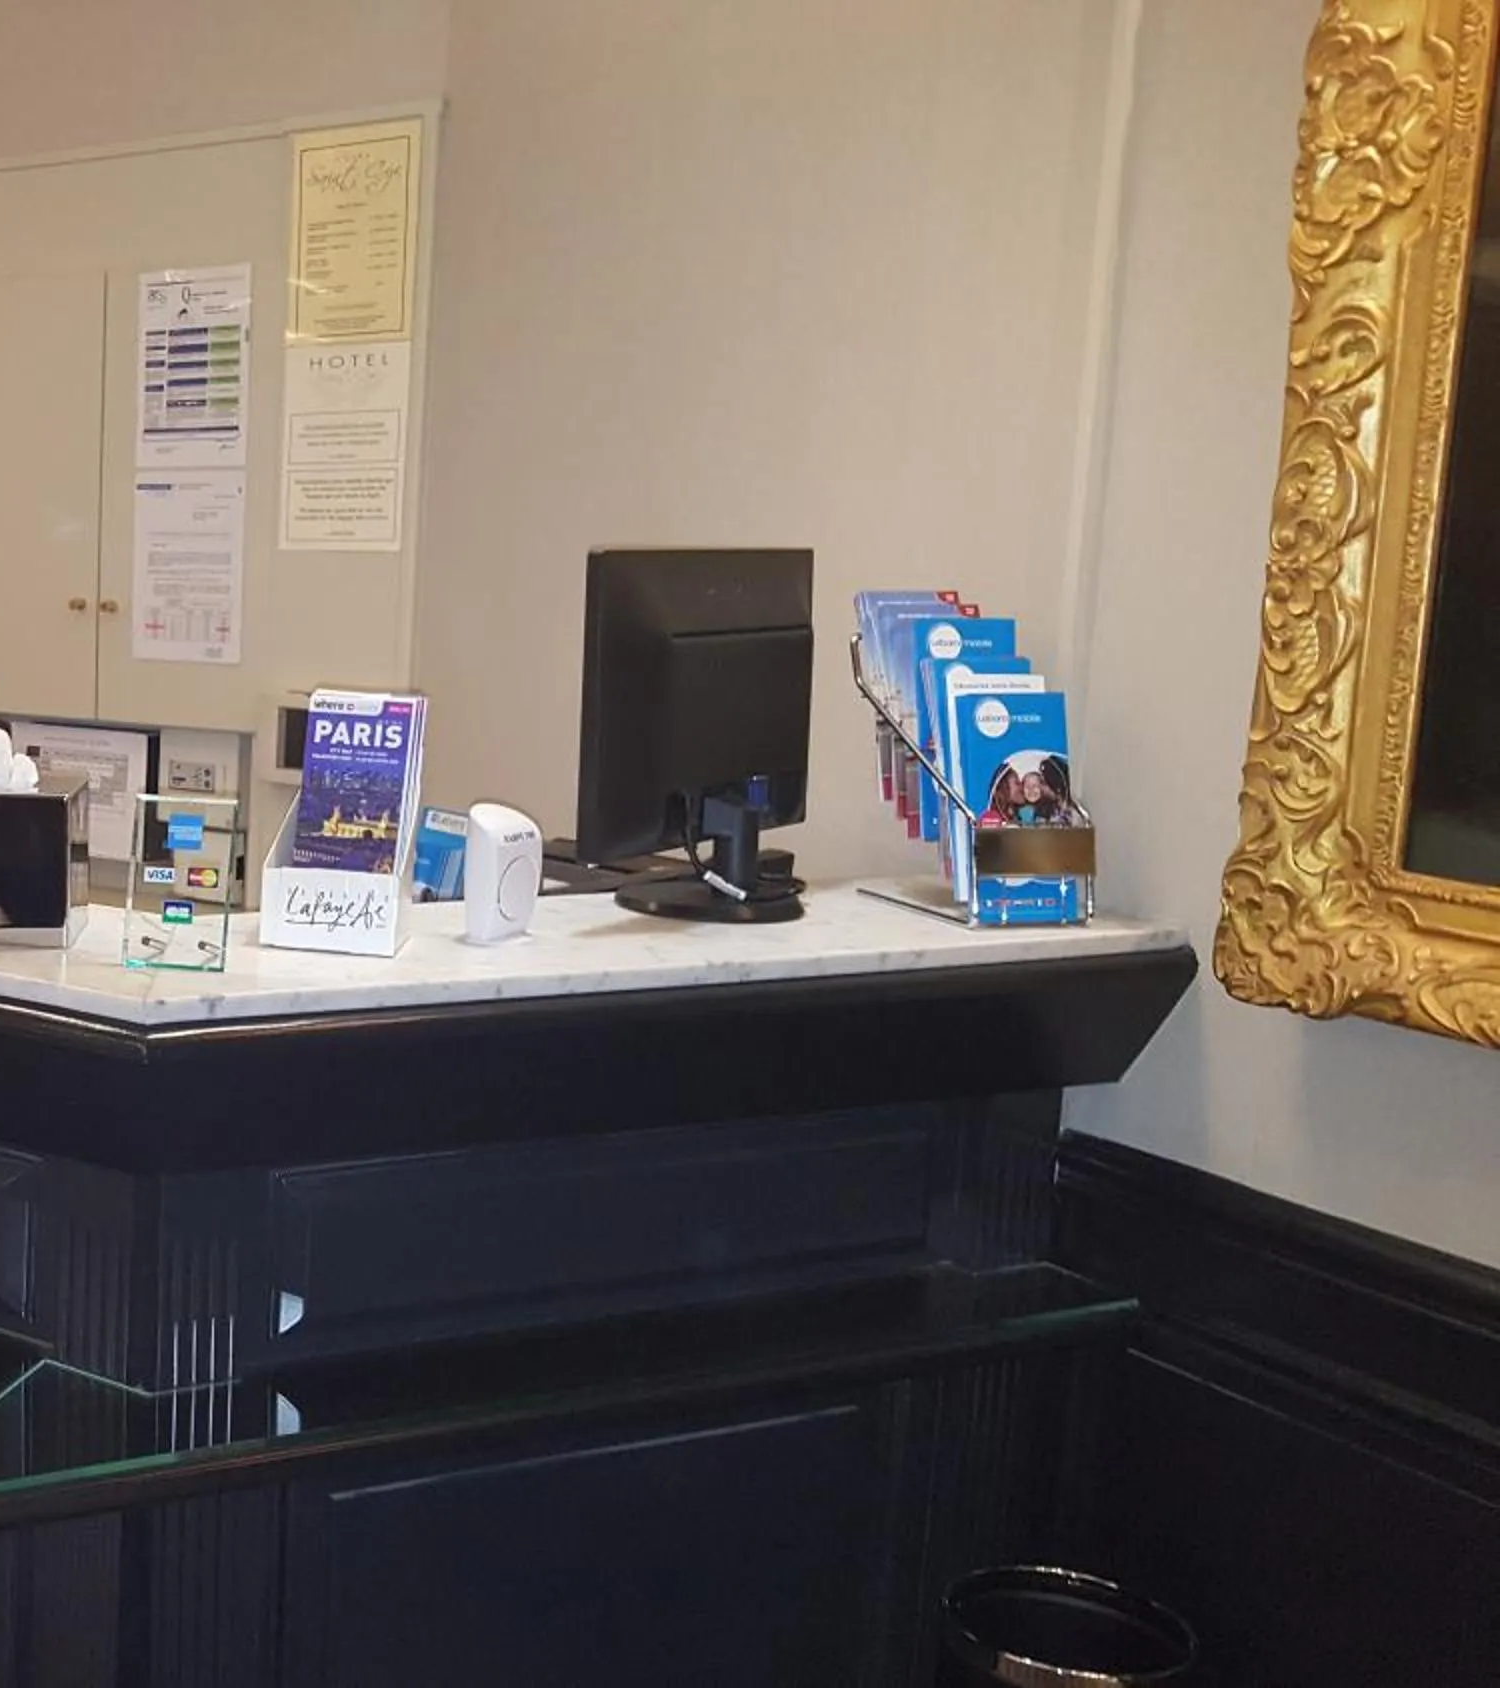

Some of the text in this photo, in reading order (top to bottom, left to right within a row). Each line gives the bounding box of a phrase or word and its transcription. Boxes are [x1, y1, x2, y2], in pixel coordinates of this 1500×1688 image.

[309, 353, 389, 370] HOTEL
[313, 719, 403, 749] PARIS
[147, 868, 174, 881] VISA
